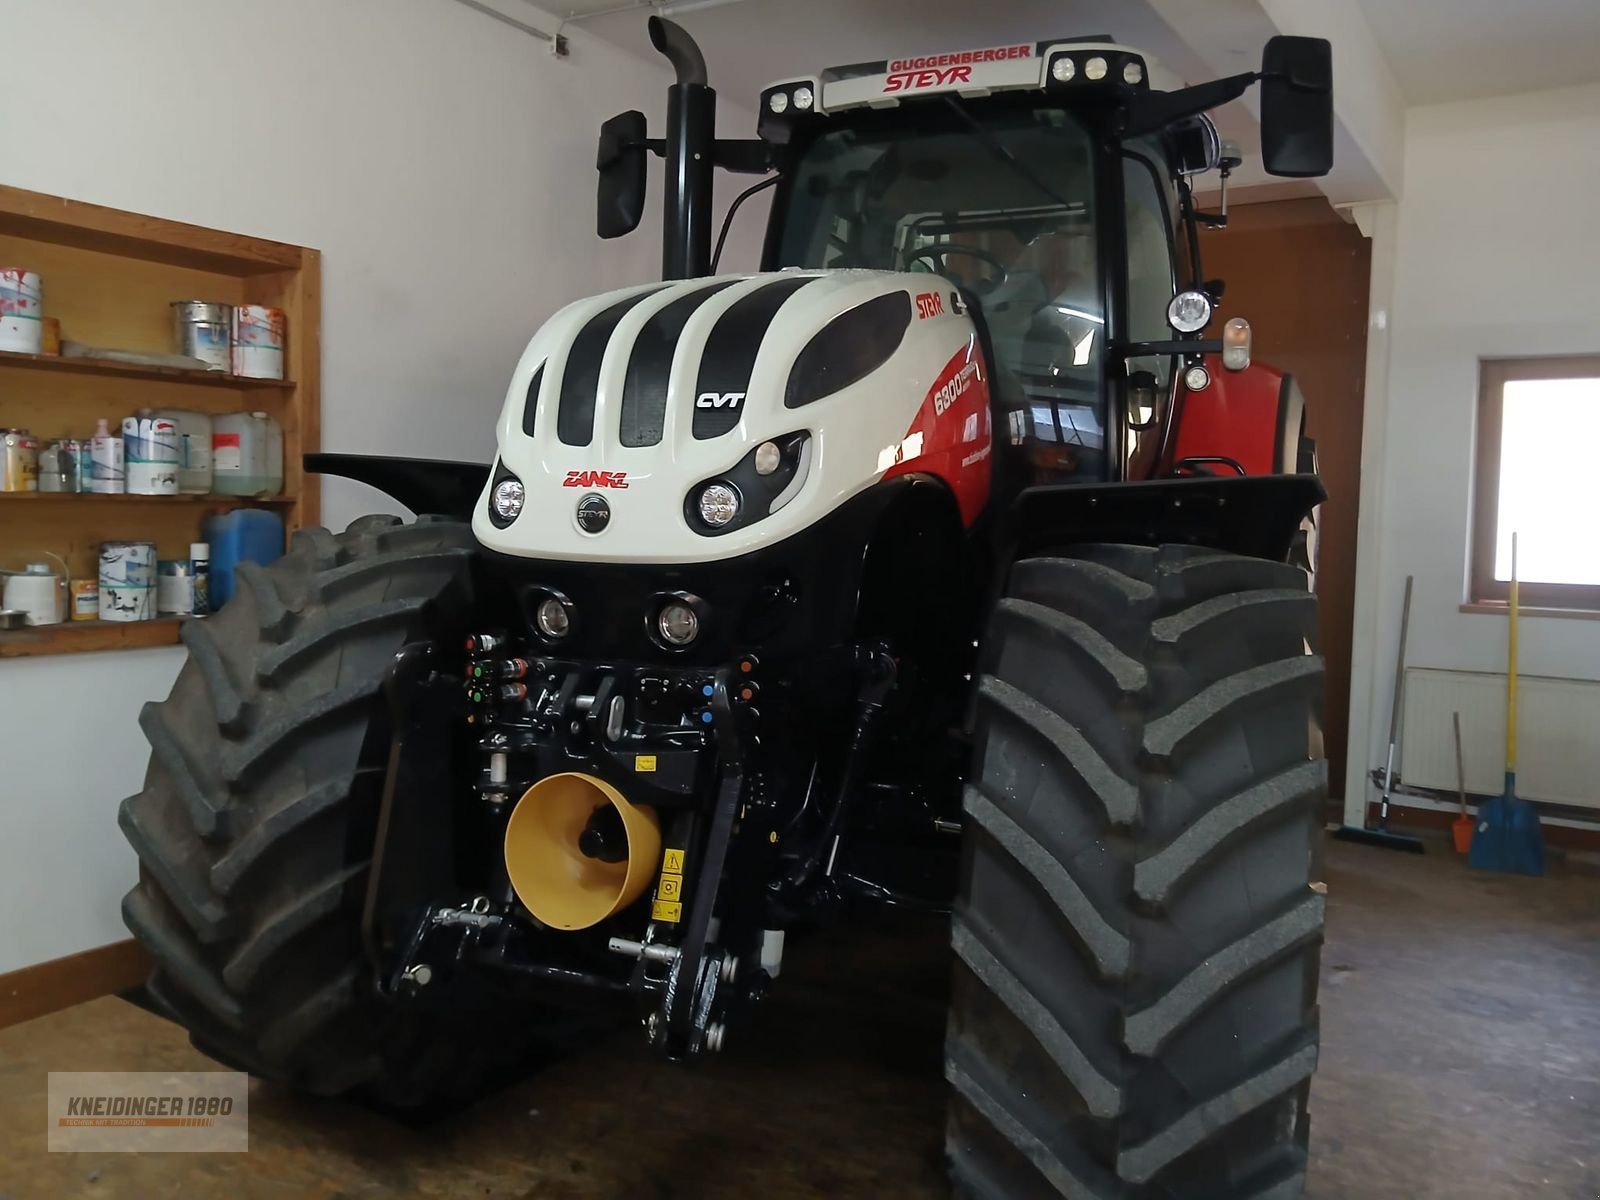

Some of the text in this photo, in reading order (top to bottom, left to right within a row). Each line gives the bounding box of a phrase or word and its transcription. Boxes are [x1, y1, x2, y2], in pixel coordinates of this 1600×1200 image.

[890, 45, 1031, 73] GUGGENBERGER
[883, 65, 972, 93] STEYR
[915, 291, 945, 320] STEYR
[696, 392, 746, 408] CVT
[933, 372, 962, 416] 6300
[577, 510, 609, 519] STEYR
